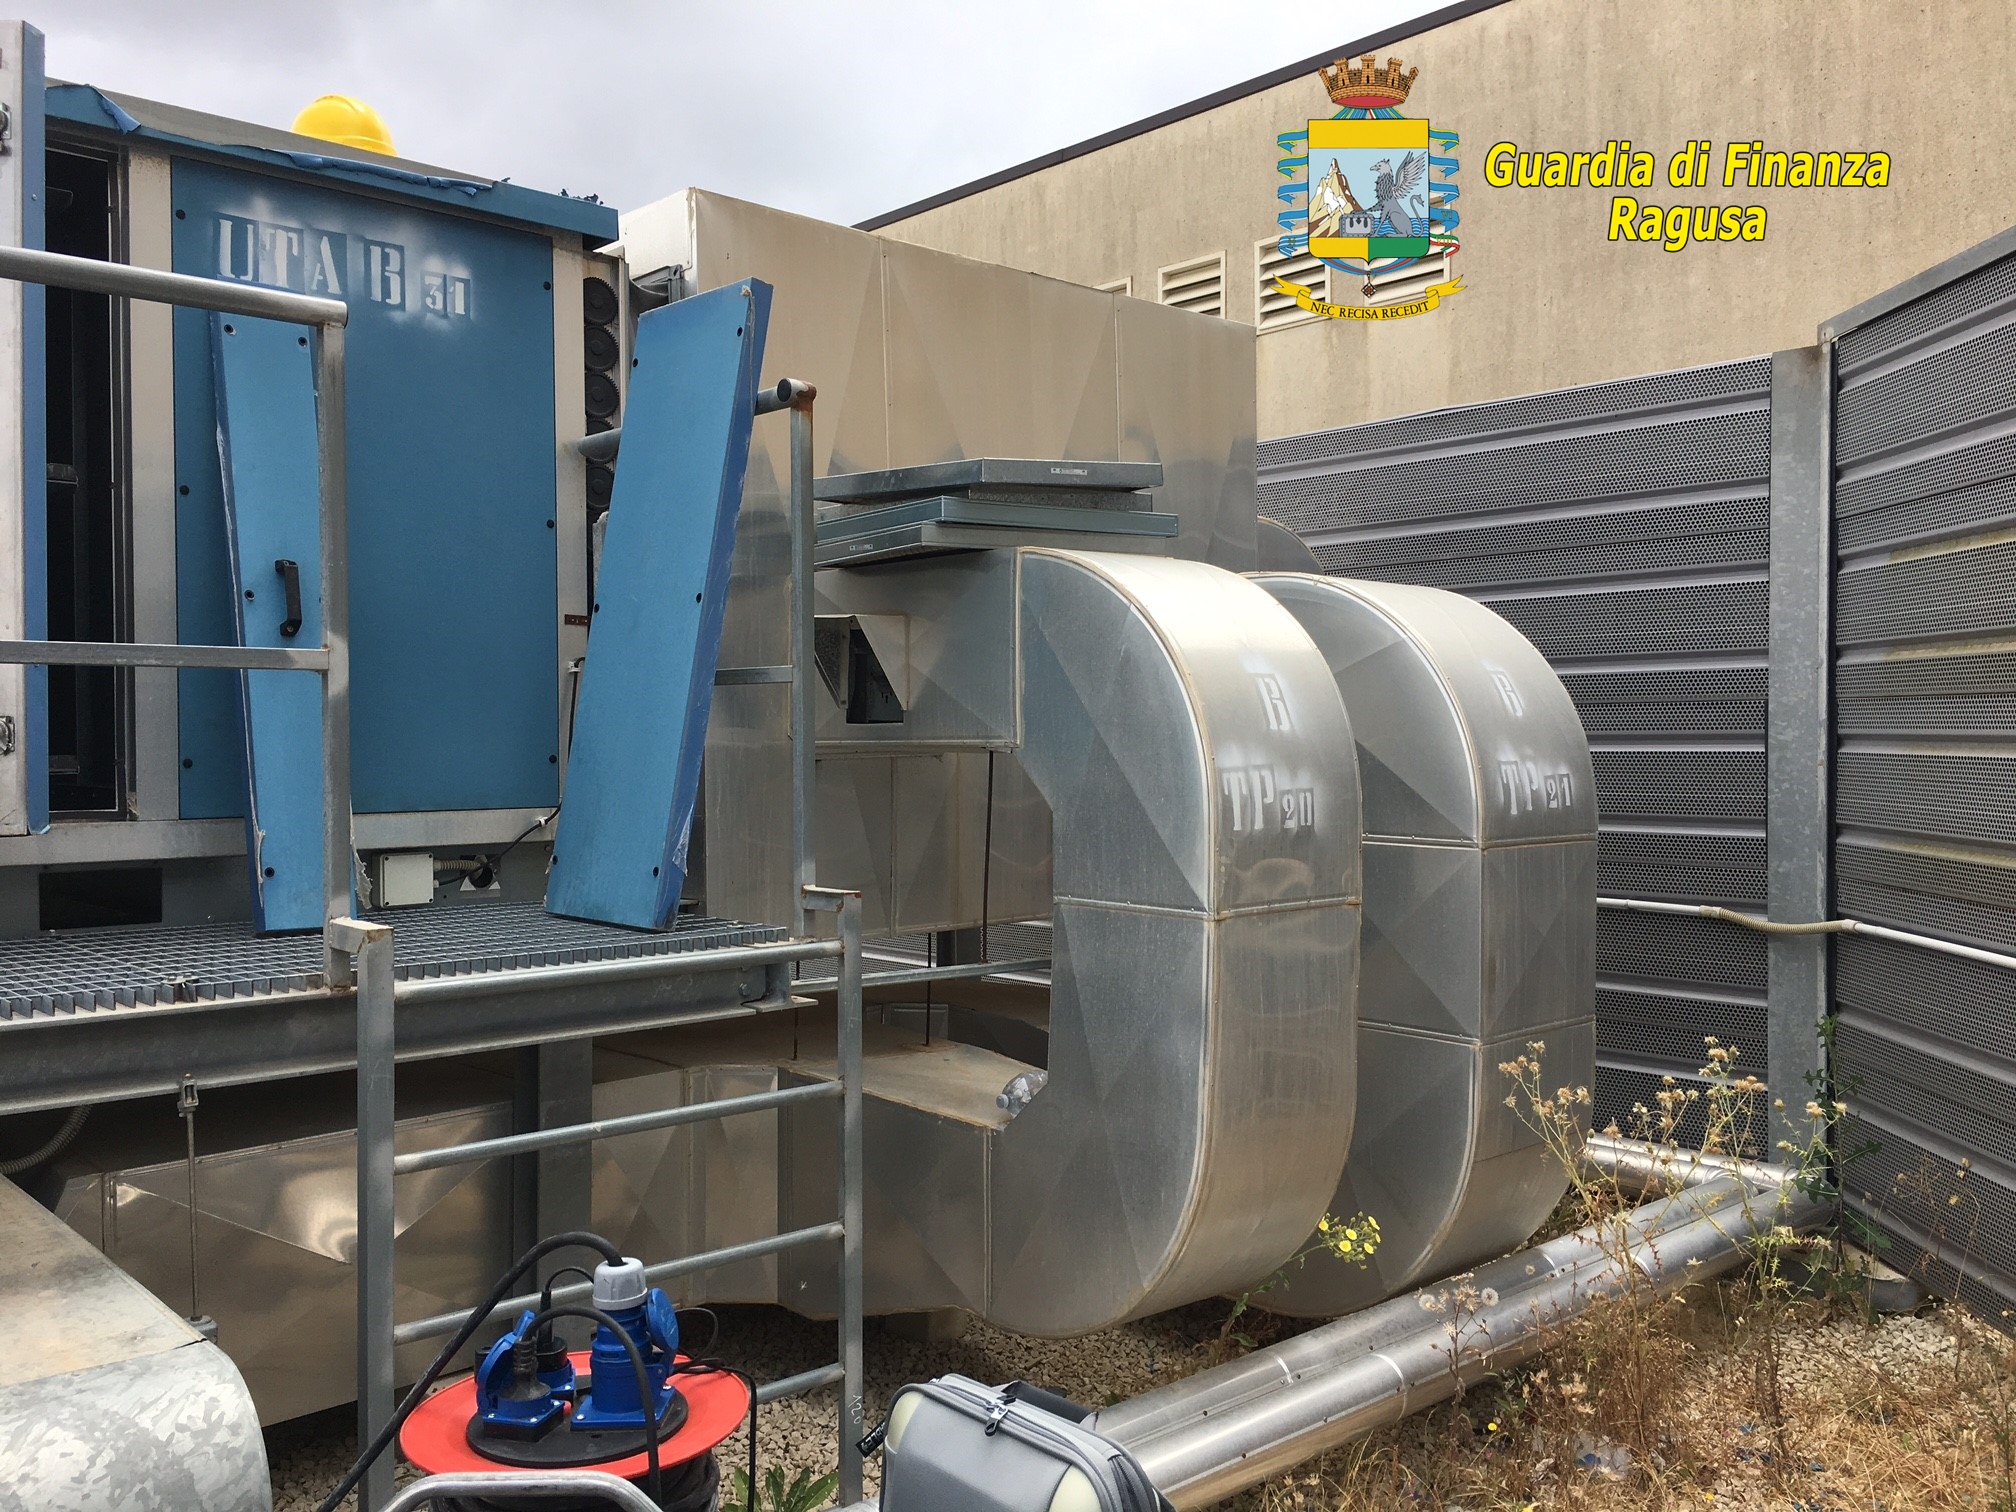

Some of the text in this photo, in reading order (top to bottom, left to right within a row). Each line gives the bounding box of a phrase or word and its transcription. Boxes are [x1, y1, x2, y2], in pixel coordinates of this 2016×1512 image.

[219, 218, 466, 315] UTA B 31
[1255, 676, 1292, 732] B
